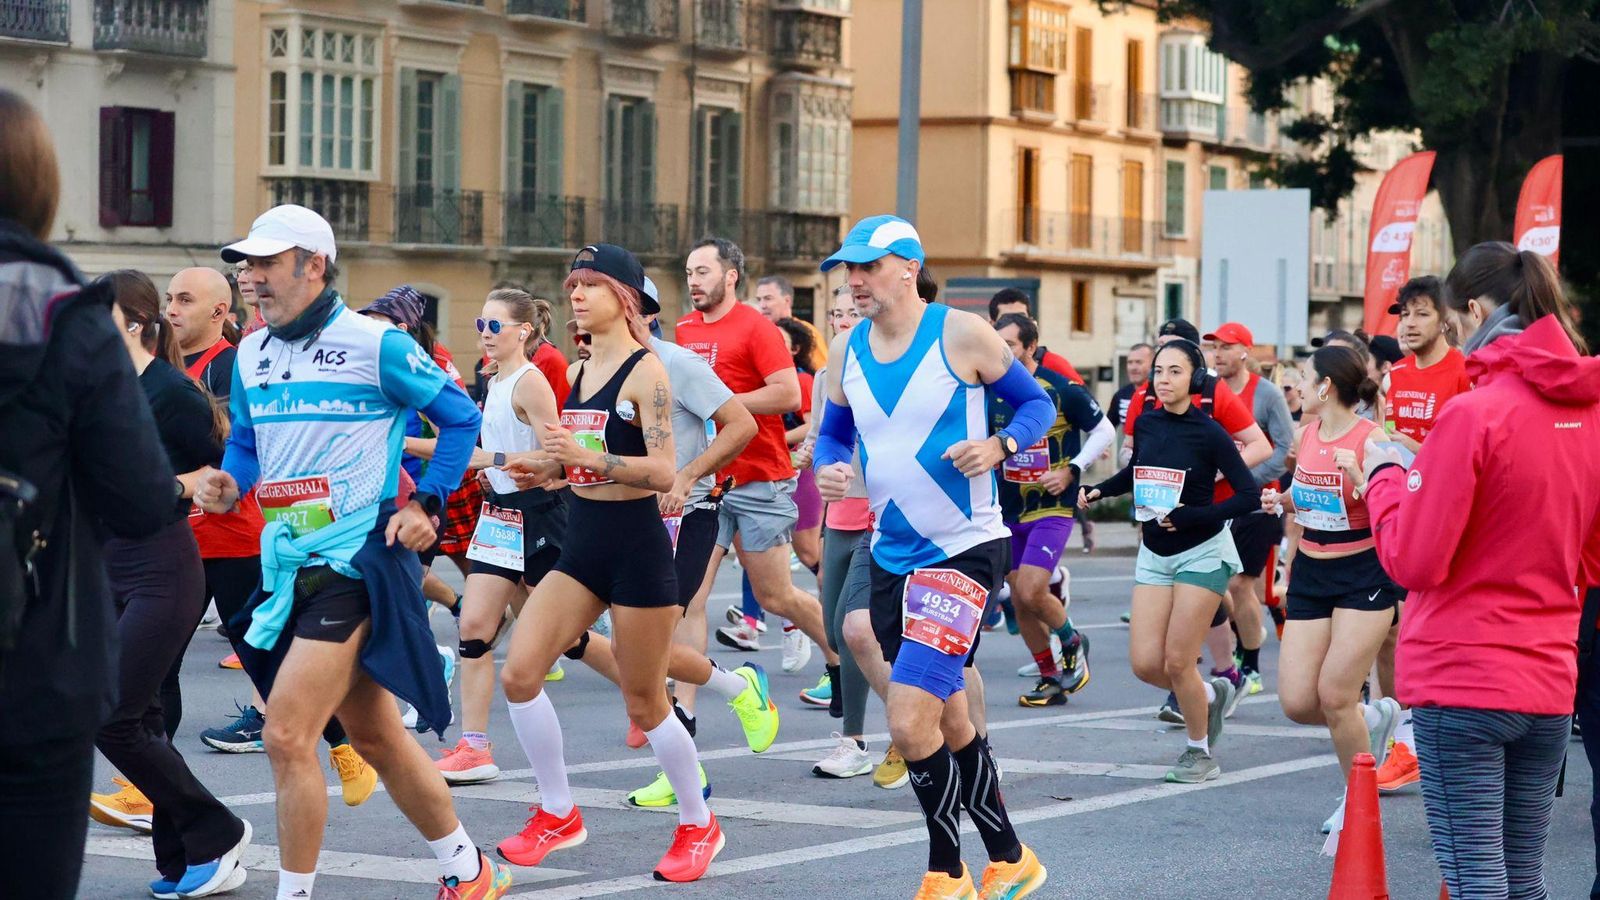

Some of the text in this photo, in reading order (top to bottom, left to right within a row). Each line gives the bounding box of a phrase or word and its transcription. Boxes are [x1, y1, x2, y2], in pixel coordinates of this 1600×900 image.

[312, 349, 347, 366] ACS
[560, 414, 602, 426] GENERALI
[1143, 470, 1180, 482] GENERALI
[1299, 473, 1336, 486] GENERALI
[268, 480, 324, 498] GENERALI
[1140, 487, 1168, 501] 13211
[1298, 490, 1331, 506] 13212
[931, 571, 982, 602] GENERALI
[921, 591, 962, 619] 4934
